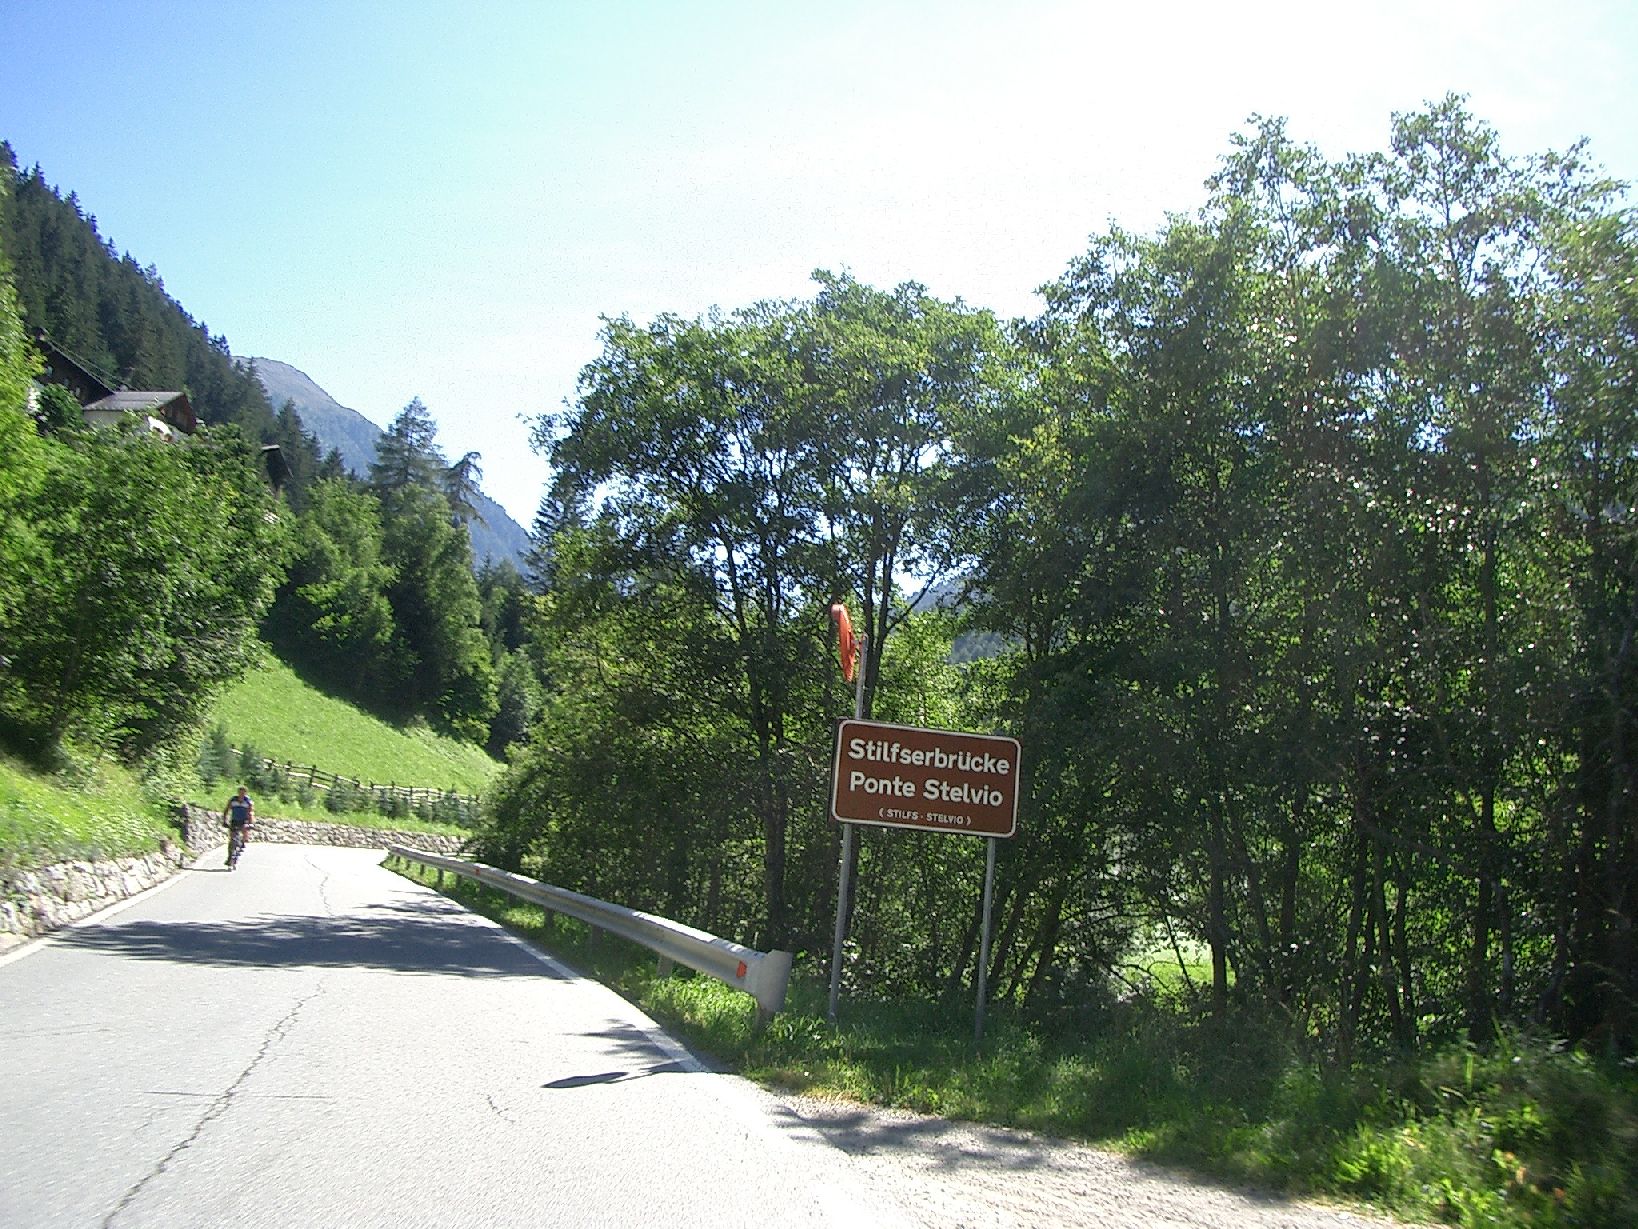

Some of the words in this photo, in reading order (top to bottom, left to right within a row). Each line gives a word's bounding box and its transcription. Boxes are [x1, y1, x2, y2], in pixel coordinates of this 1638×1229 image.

[848, 738, 1010, 775] Stilfserbrücke
[849, 771, 916, 797] Ponte
[923, 779, 1004, 806] Stelvio
